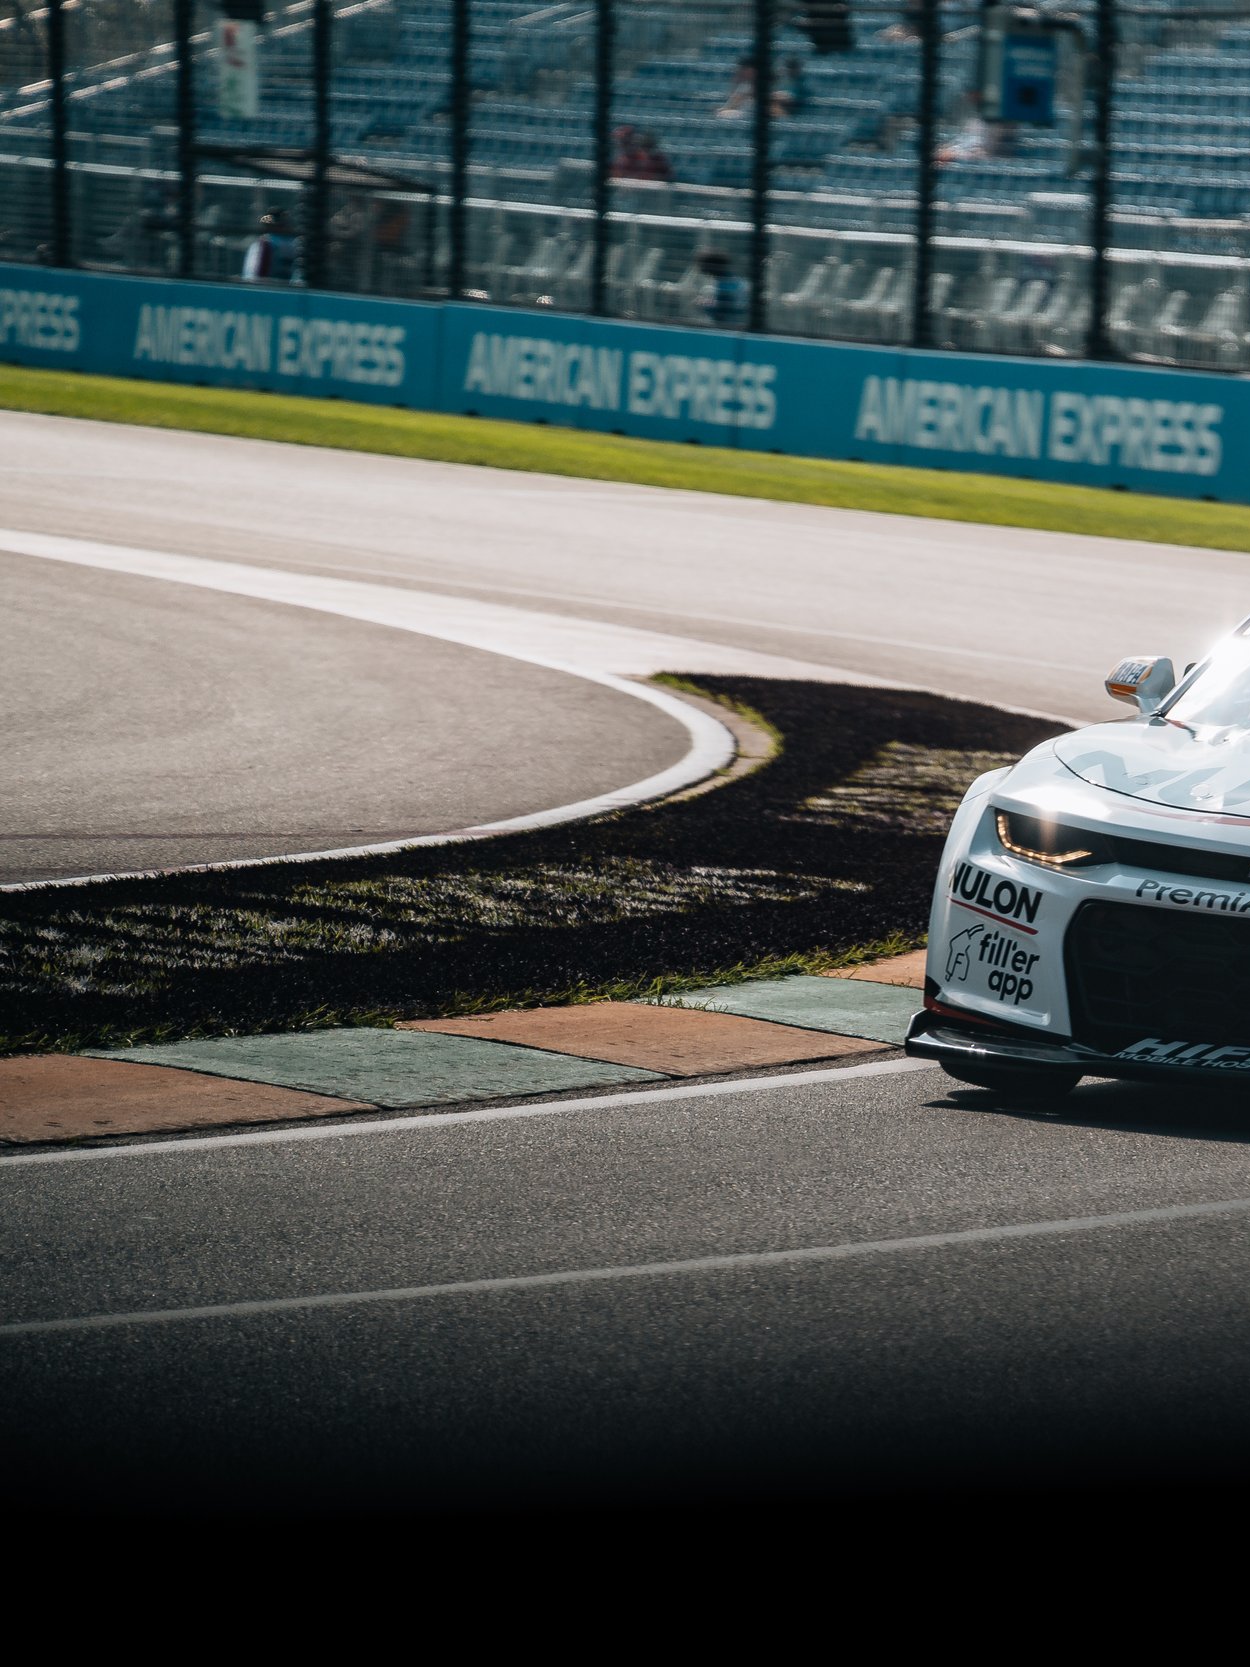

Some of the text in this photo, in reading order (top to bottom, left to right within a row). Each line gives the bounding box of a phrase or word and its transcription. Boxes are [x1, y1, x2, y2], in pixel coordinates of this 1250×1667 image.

[134, 304, 407, 388] AMERICAN EXPRESS
[464, 333, 777, 431] AMERICAN EXPRESS
[854, 374, 1223, 476] AMERICAN EXPRESS
[949, 861, 1043, 924] NULON
[988, 969, 1033, 1005] app
[1111, 1051, 1200, 1067] MOBILE
